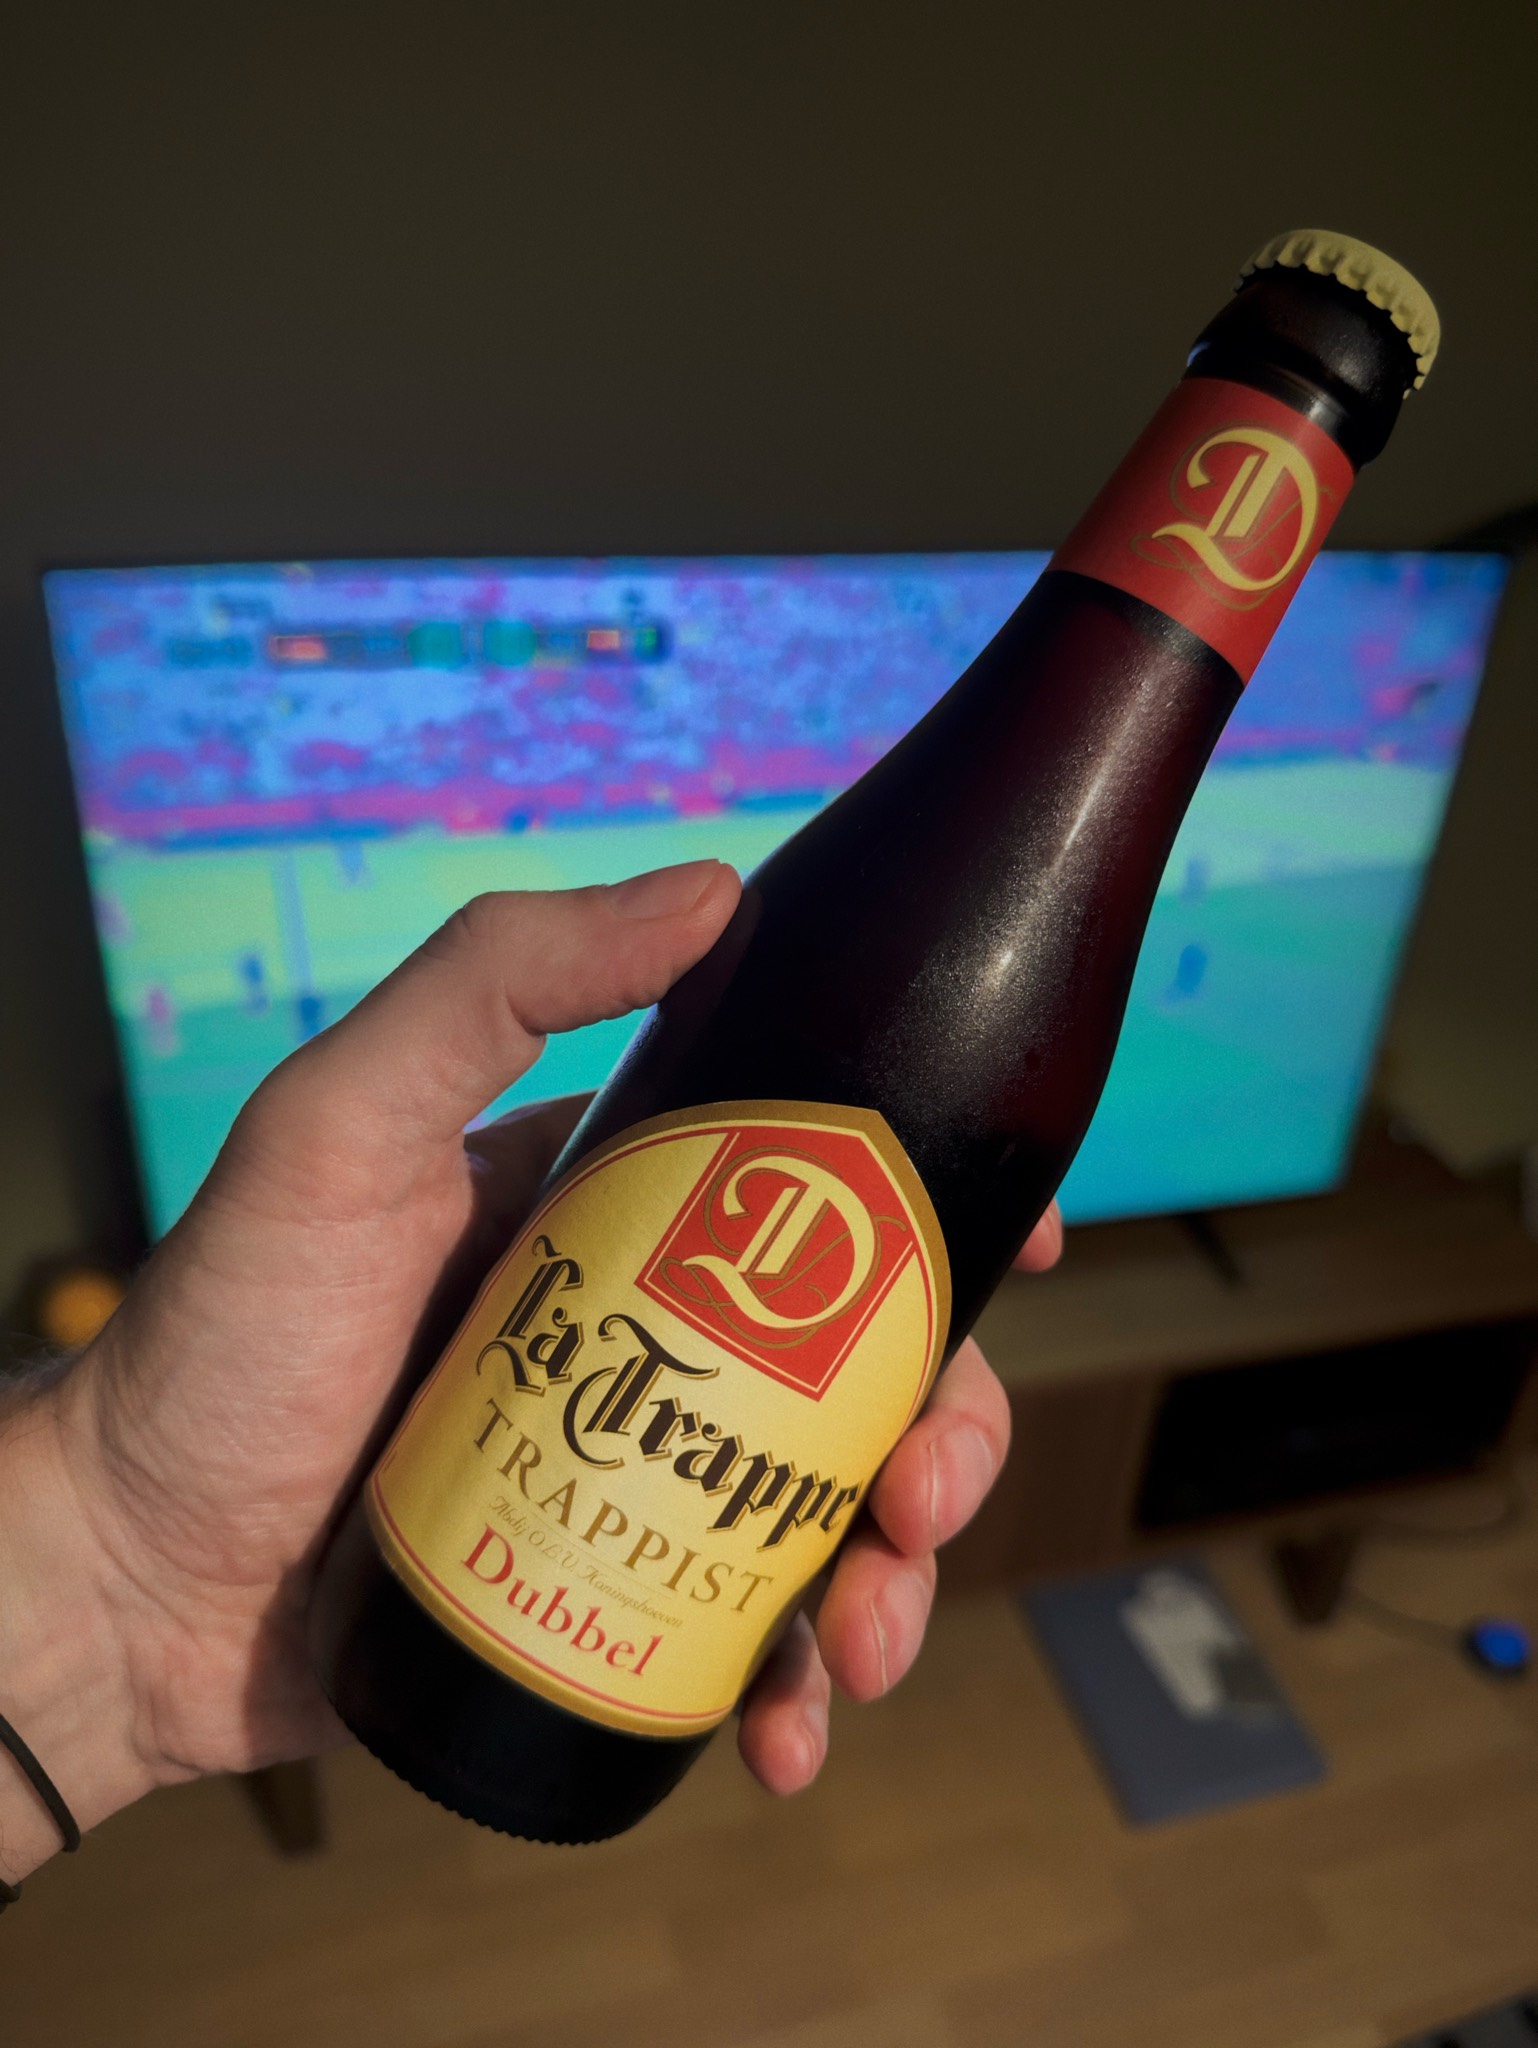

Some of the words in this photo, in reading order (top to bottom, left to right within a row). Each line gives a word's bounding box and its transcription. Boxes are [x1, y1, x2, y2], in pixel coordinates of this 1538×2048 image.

[476, 1234, 585, 1397] La
[563, 1313, 865, 1553] Trappe
[473, 1398, 774, 1613] TRAPPIST
[491, 1495, 528, 1537] Abdij
[579, 1564, 684, 1629] Koningshoeven
[460, 1523, 665, 1677] Dubbel
